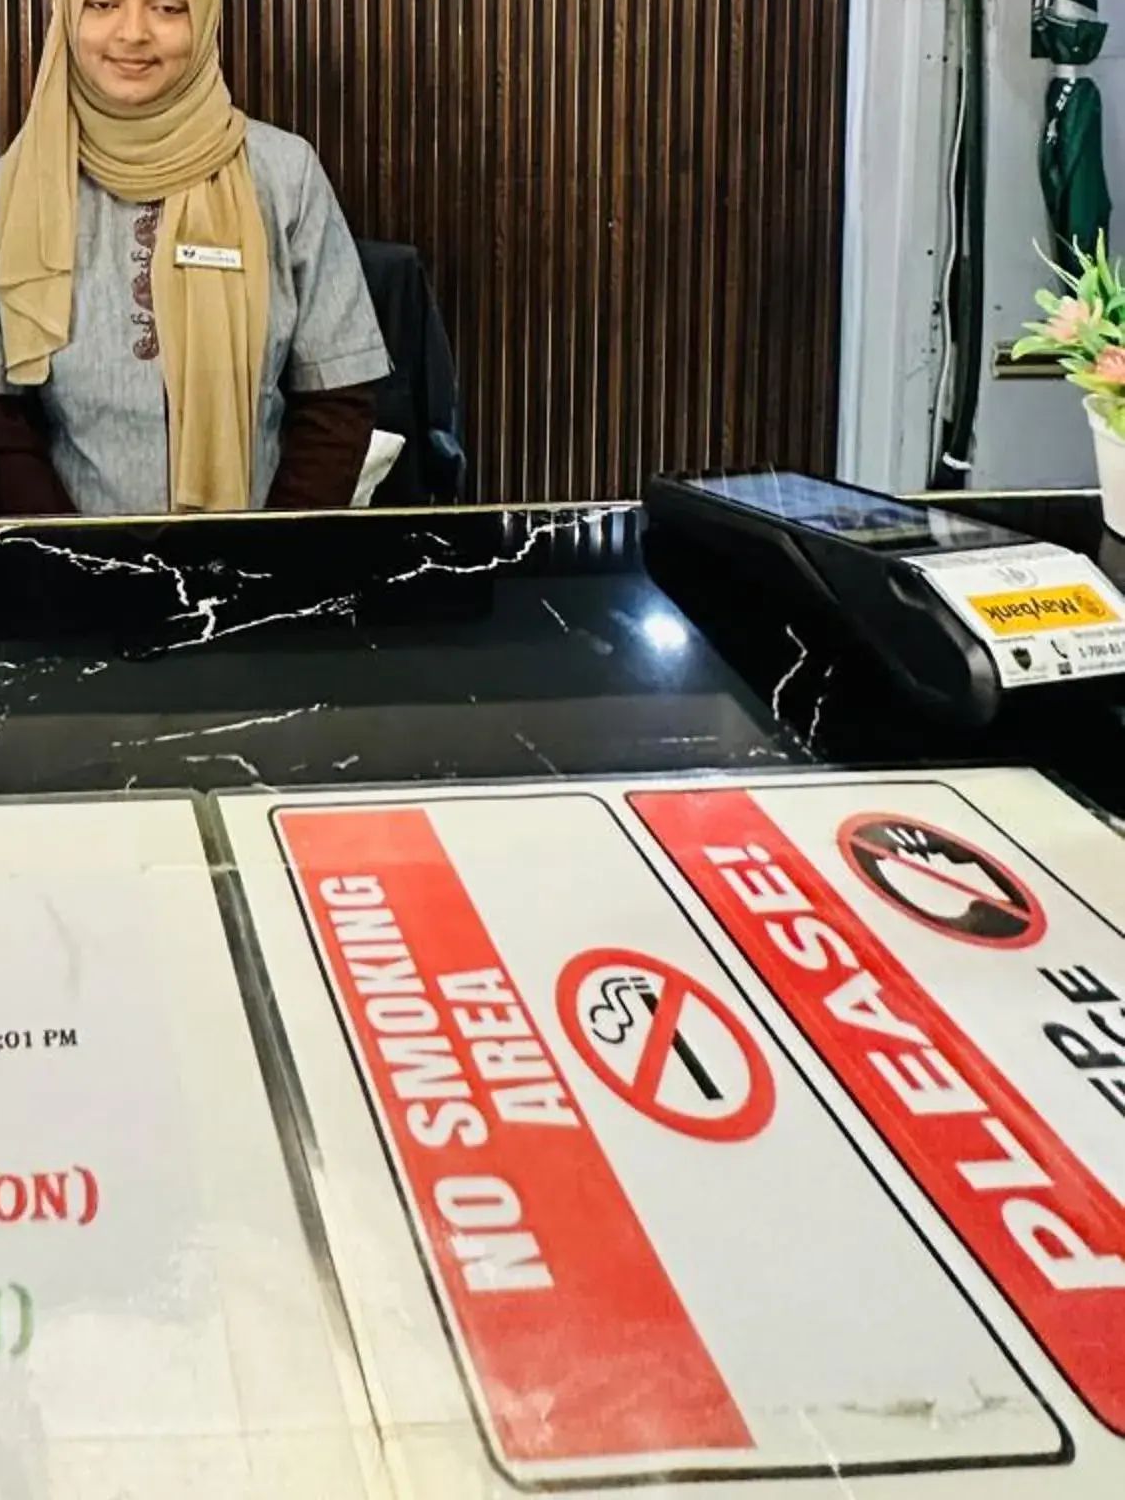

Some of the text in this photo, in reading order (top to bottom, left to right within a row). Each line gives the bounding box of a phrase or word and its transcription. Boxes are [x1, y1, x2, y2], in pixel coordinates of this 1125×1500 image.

[982, 597, 1080, 624] Maybank
[43, 1028, 78, 1048] PM
[318, 874, 556, 1294] NO SMOKING
[436, 967, 583, 1129] AREA
[701, 843, 1125, 1291] PLEASE!
